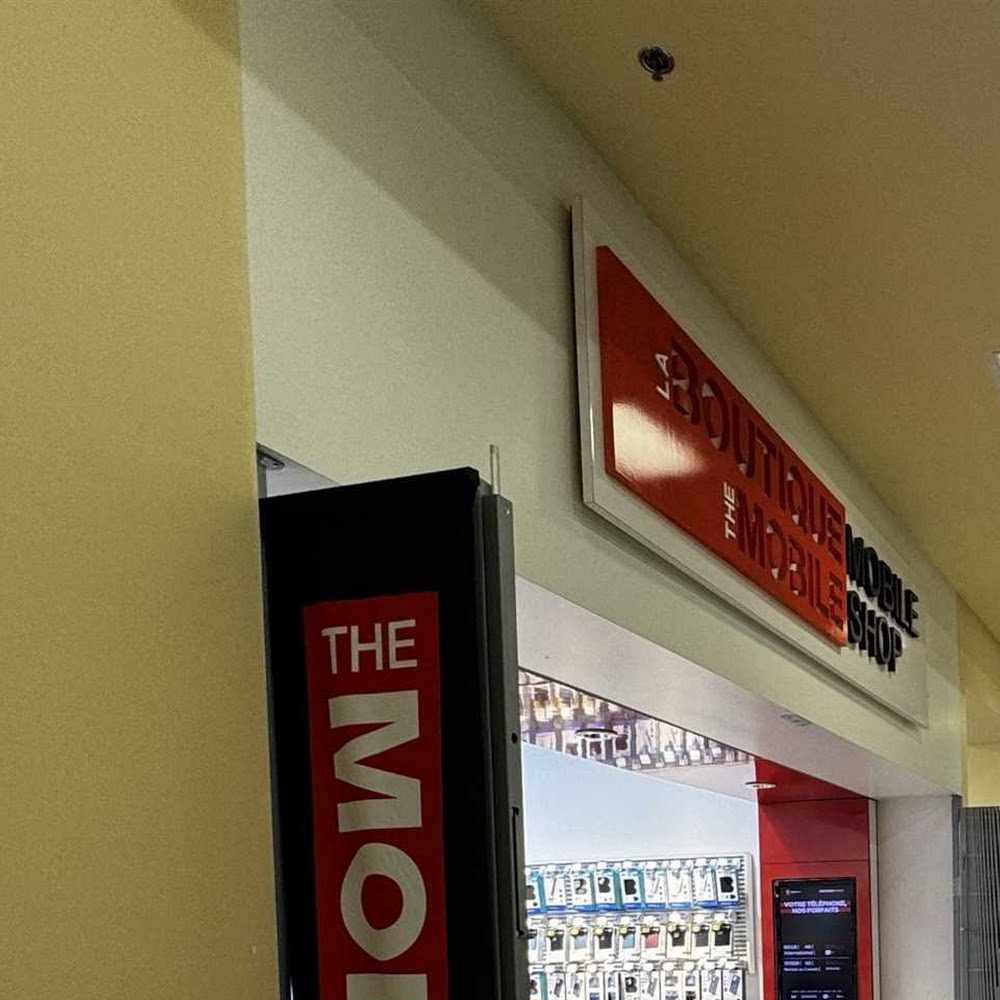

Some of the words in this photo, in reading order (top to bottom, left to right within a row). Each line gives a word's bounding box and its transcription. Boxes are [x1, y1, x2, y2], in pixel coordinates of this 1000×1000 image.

[655, 352, 671, 400] LA
[671, 336, 842, 566] BOUTIQUE
[723, 481, 737, 540] THE
[737, 487, 843, 632] MOBILE
[845, 523, 918, 638] MOBILE
[321, 619, 418, 675] THE
[847, 590, 902, 673] SHOP
